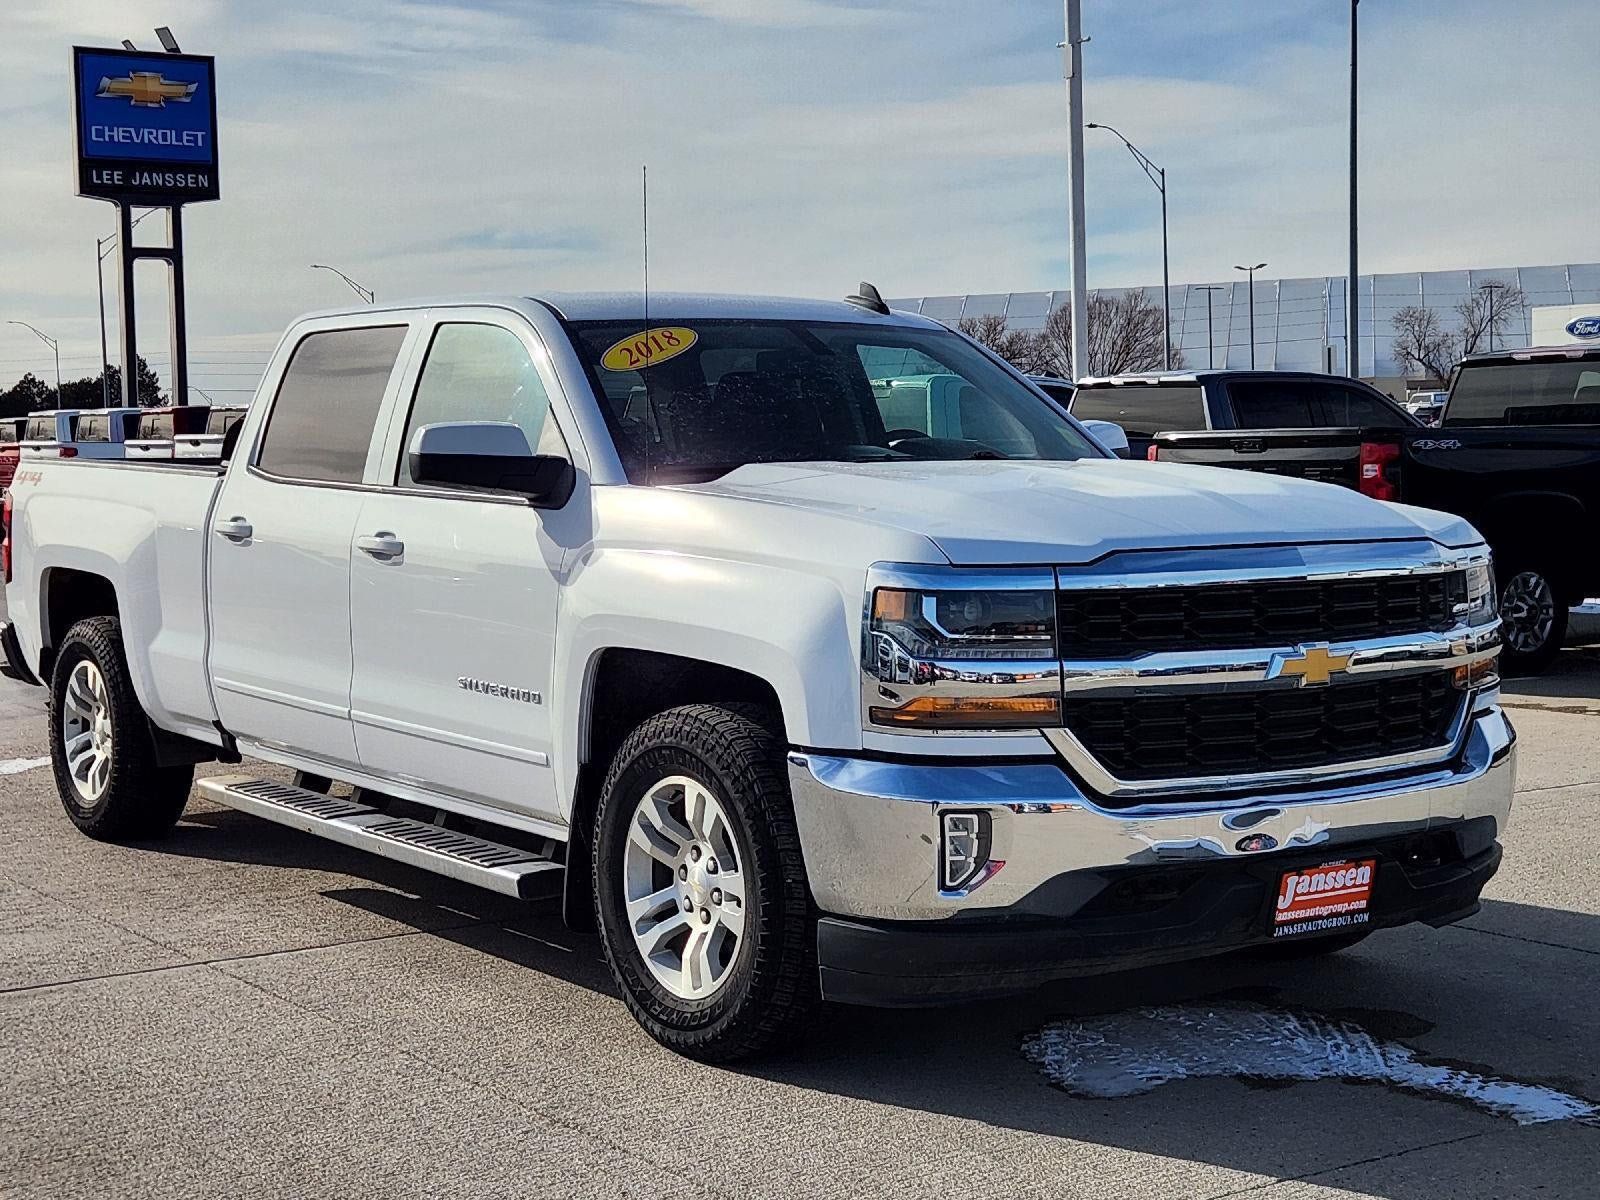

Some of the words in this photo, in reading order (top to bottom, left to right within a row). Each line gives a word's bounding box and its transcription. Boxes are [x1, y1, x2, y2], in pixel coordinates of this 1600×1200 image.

[91, 125, 206, 147] CHEVROLET
[92, 169, 124, 185] LEE
[131, 171, 209, 188] JANSSEN
[1574, 321, 1600, 335] Ford
[619, 330, 681, 367] 2018
[457, 676, 543, 705] SILVERADO
[1277, 865, 1371, 910] Janssen
